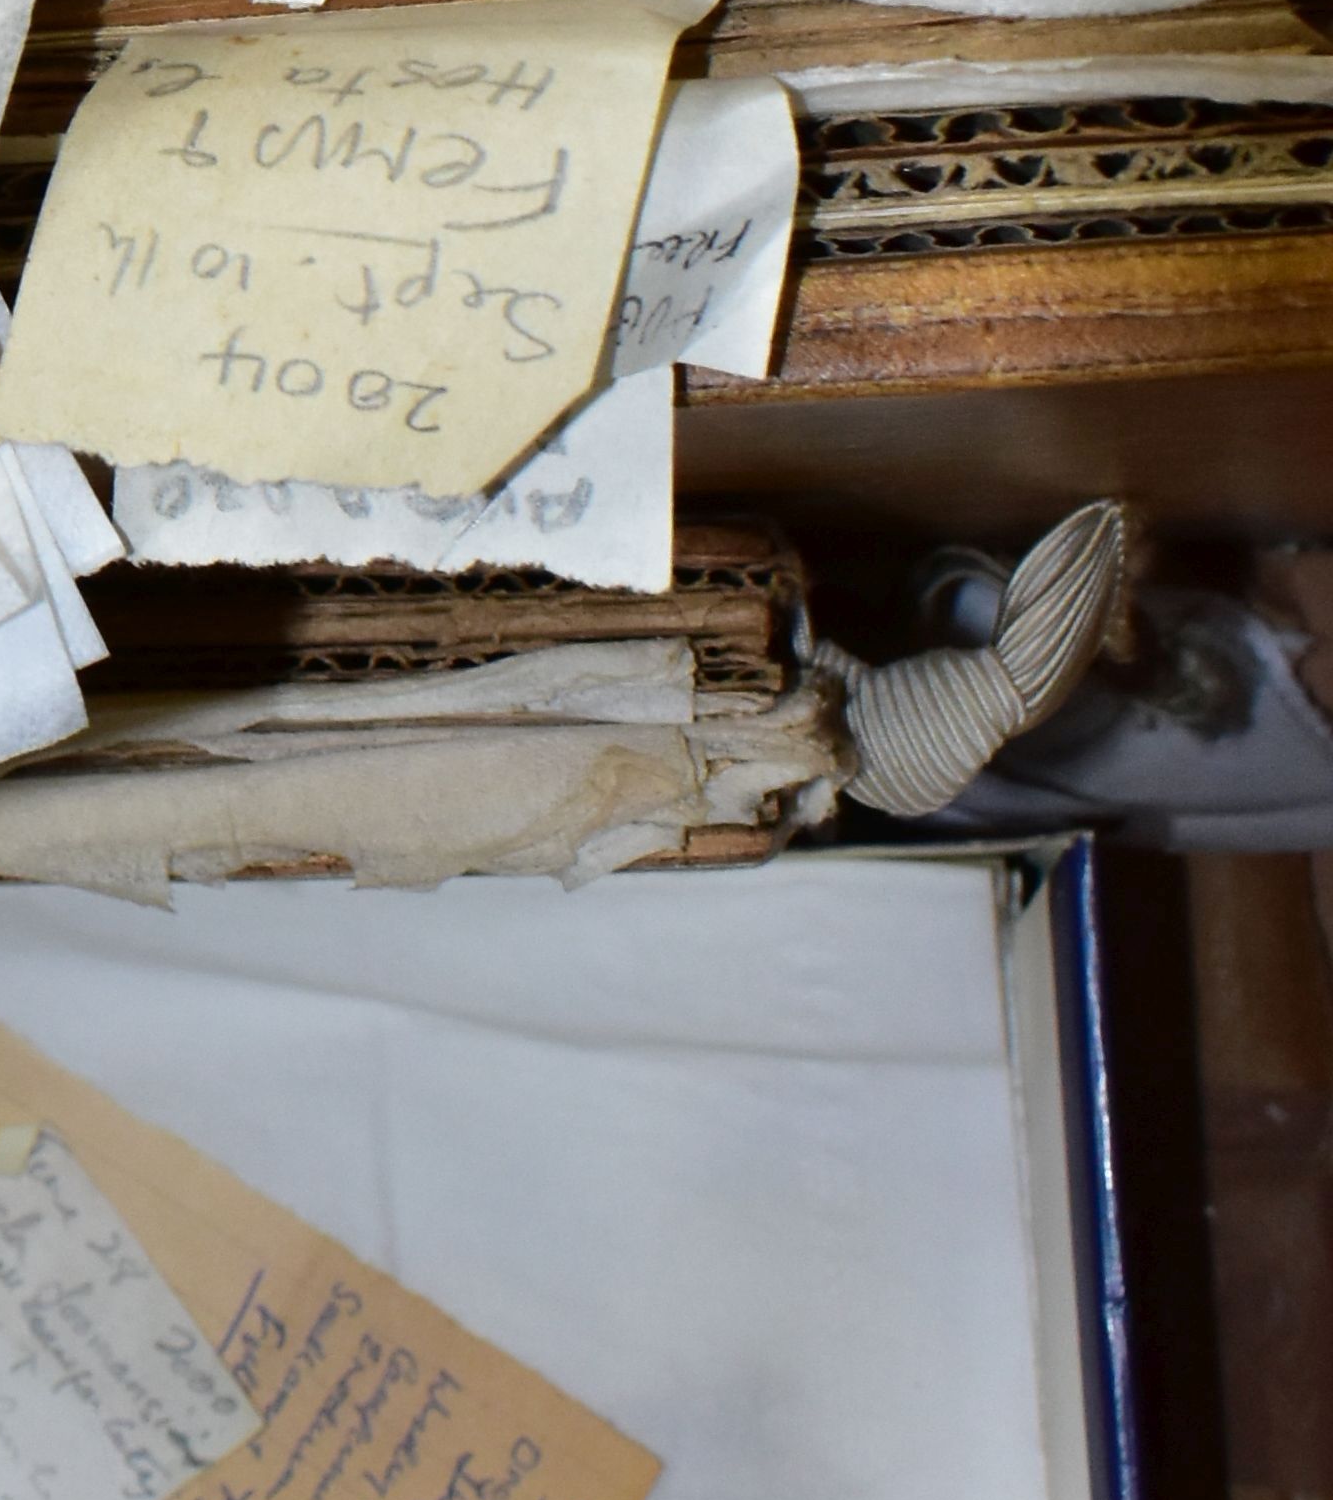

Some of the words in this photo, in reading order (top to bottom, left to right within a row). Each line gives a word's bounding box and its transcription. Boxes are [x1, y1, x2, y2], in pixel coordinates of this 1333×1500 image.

[281, 50, 554, 111] Hosta
[253, 114, 569, 232] Ferns
[199, 325, 449, 434] 2004
